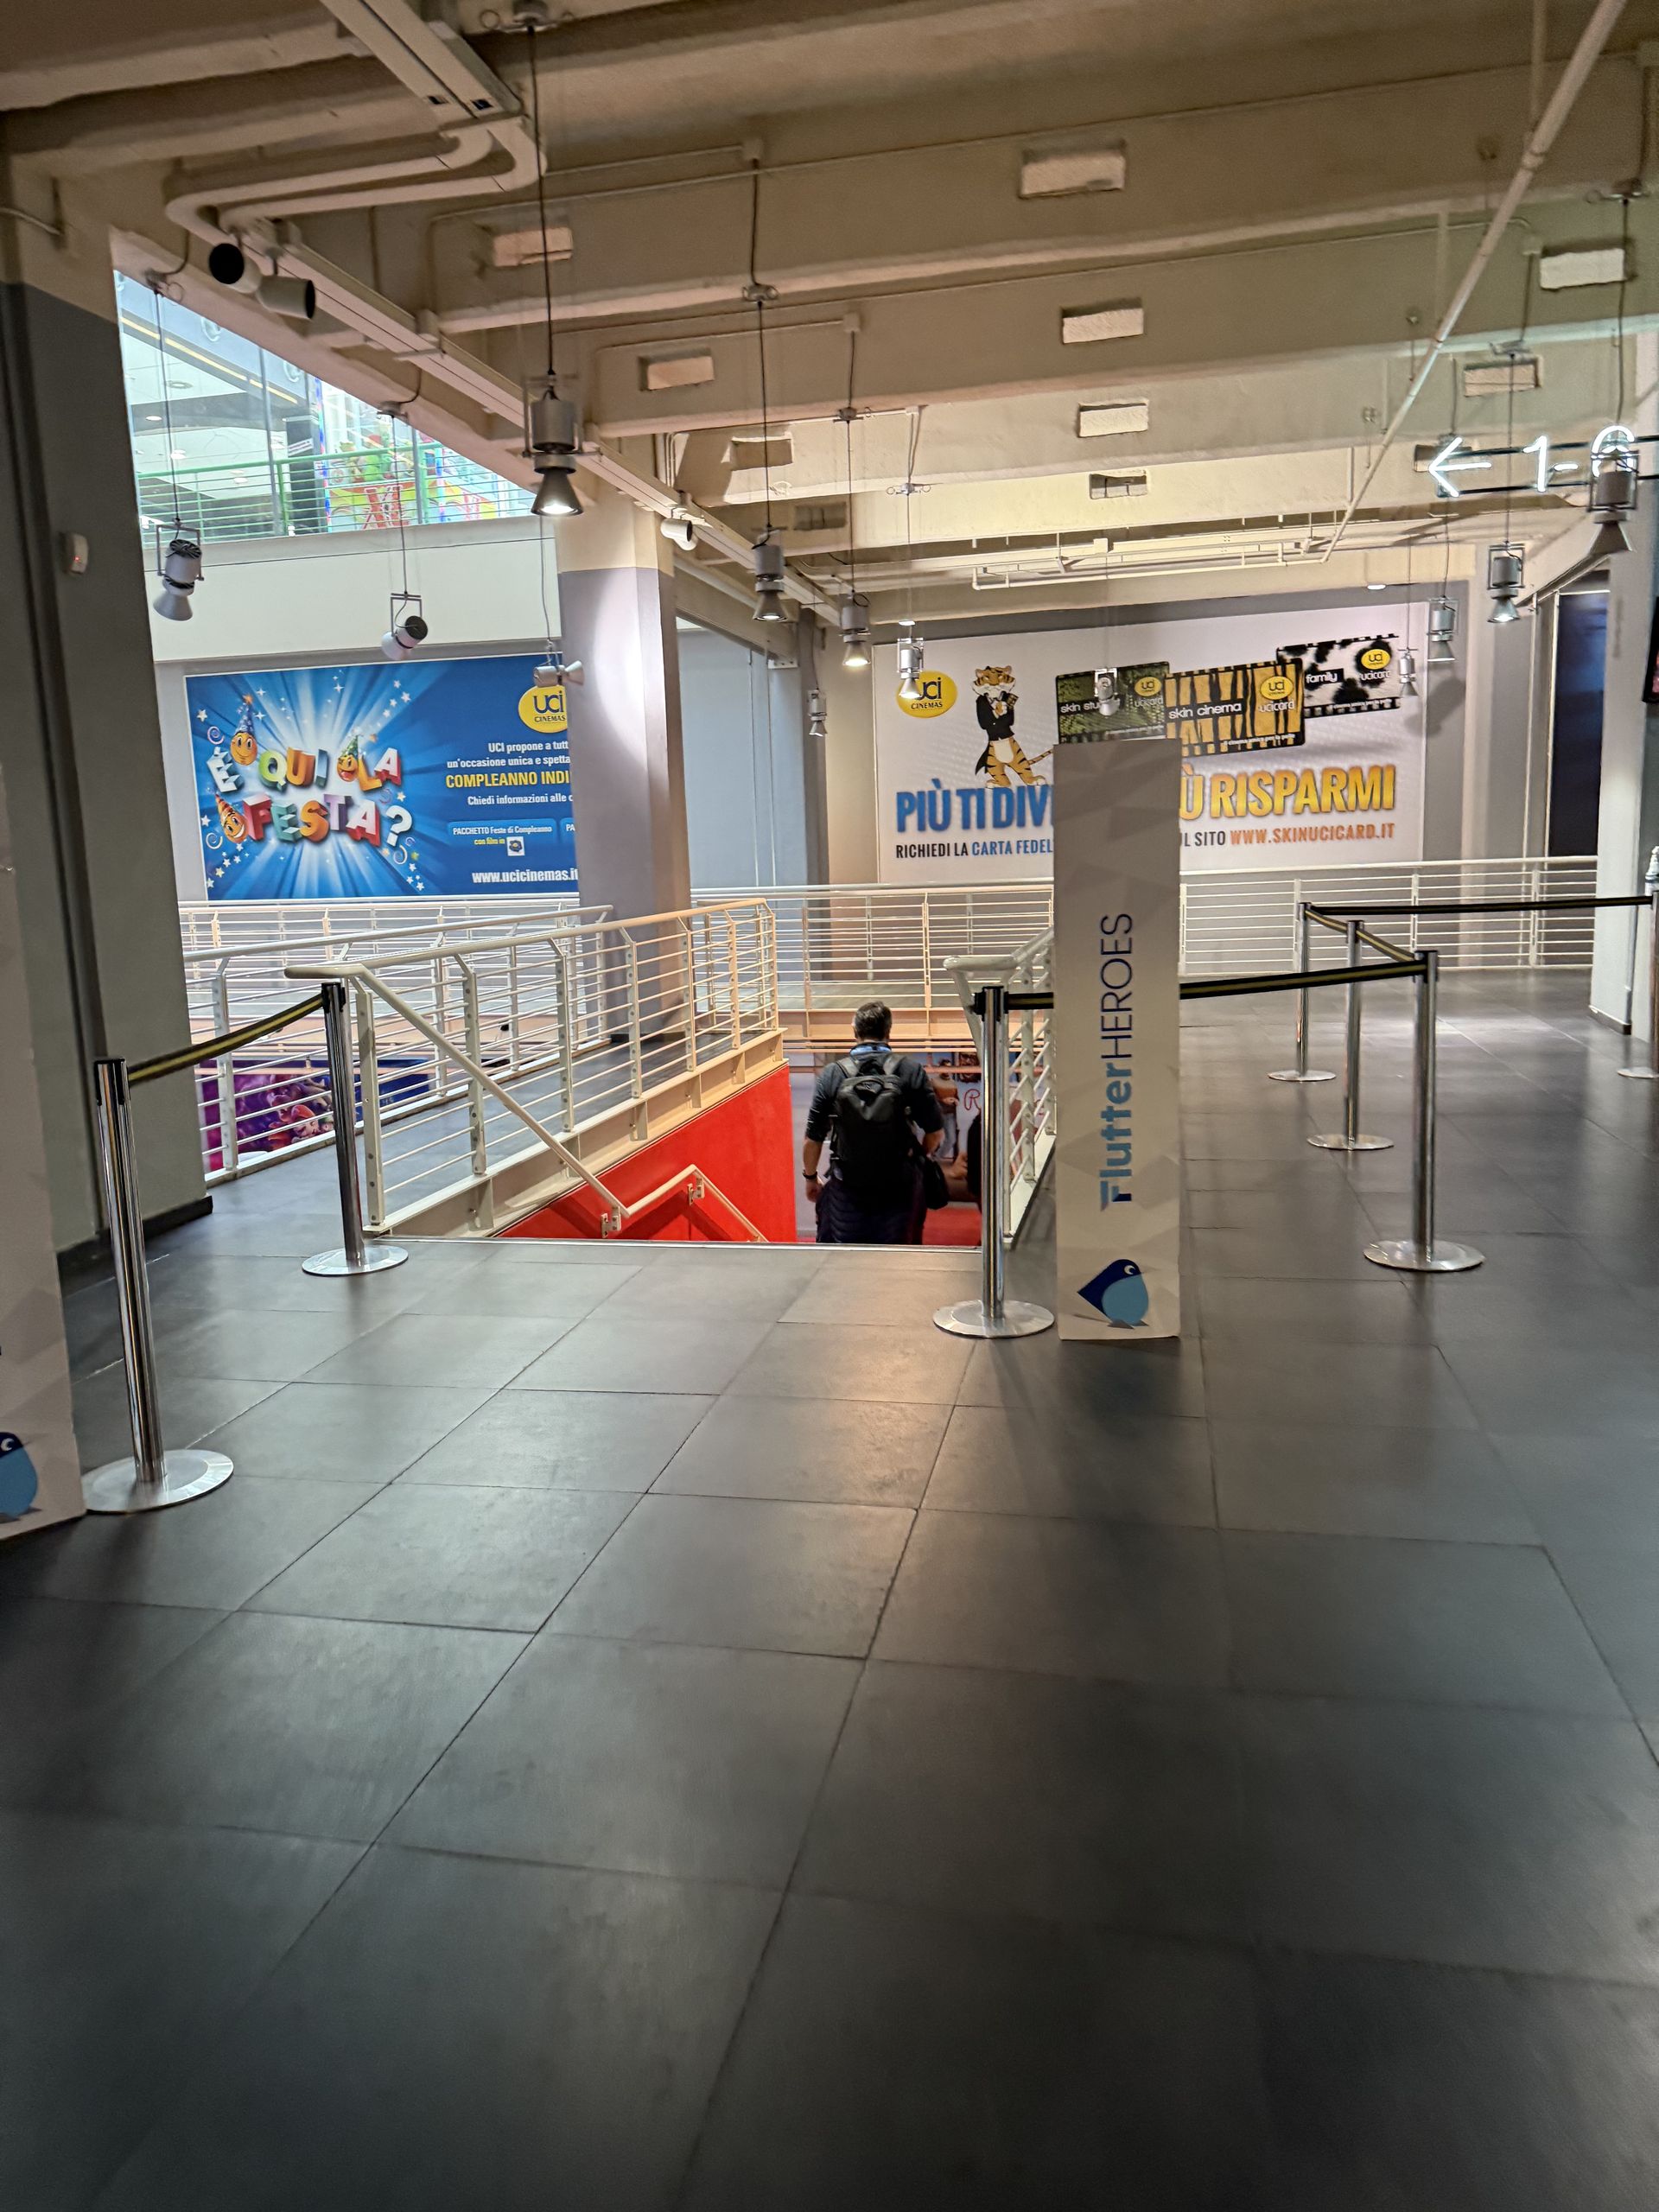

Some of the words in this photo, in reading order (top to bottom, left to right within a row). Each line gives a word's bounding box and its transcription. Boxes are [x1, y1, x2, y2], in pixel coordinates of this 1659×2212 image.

[1306, 671, 1338, 683] family
[1268, 680, 1285, 691] uci
[533, 690, 565, 714] uci
[911, 701, 944, 710] CINEMAS
[1060, 703, 1081, 714] skin
[1258, 700, 1296, 713] ucicard
[1168, 708, 1194, 719] skin
[1197, 702, 1242, 715] cinema
[488, 742, 504, 753] UCI
[506, 741, 543, 754] propone
[447, 757, 506, 768] un'occasione
[508, 755, 533, 766] unica
[543, 754, 571, 768] spetta
[259, 747, 331, 791] QUI
[358, 747, 403, 792] LA
[446, 771, 537, 789] COMPLEANNO
[467, 795, 495, 805] Chiedi
[496, 793, 549, 804] informazioni
[550, 793, 567, 803] alle
[896, 778, 950, 833] PIÙ
[956, 787, 986, 830] TI
[992, 783, 1054, 830] DIV
[1210, 763, 1396, 819] RISPARMI
[242, 793, 413, 847] FESTA?
[453, 826, 489, 836] PACCHETTO
[490, 825, 506, 835] Feste
[507, 825, 514, 834] di
[514, 824, 553, 836] Compleanno
[896, 842, 950, 858] RICHIEDI
[953, 842, 969, 856] LA
[971, 840, 1013, 855] CARTA
[1016, 839, 1053, 854] FEDEL
[1194, 830, 1226, 847] SITO
[1230, 823, 1396, 845] WWW.SKINUCICARD.IT
